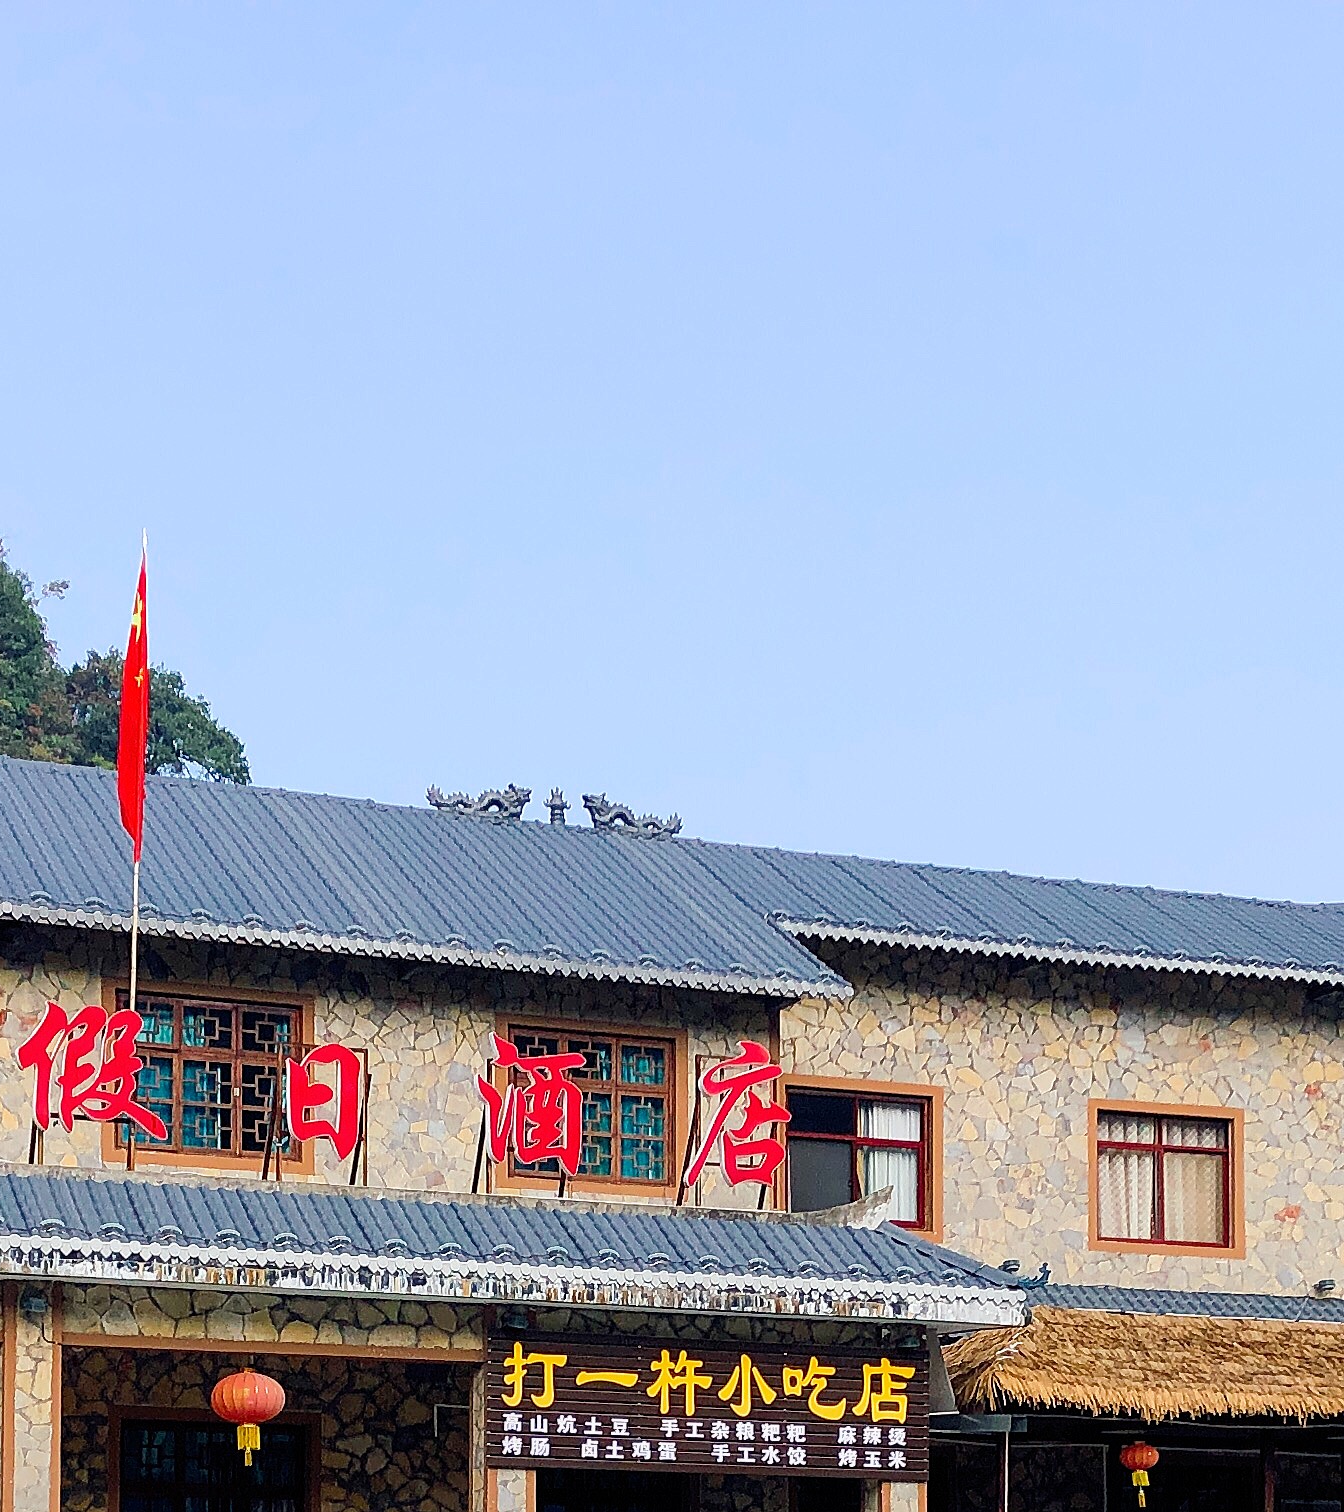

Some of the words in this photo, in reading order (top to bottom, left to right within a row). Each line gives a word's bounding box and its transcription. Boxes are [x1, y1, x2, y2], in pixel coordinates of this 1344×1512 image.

[501, 1341, 916, 1424] 打一杵小吃店
[502, 1412, 630, 1436] 高山炕土豆
[659, 1419, 806, 1443] 手工杂粮粑粑
[837, 1425, 907, 1447] 麻辣烫
[501, 1436, 550, 1457] 烤肠
[581, 1439, 677, 1461] 卤土鸡蛋
[711, 1444, 807, 1466] 手工水饺
[837, 1448, 907, 1470] 烤玉米
